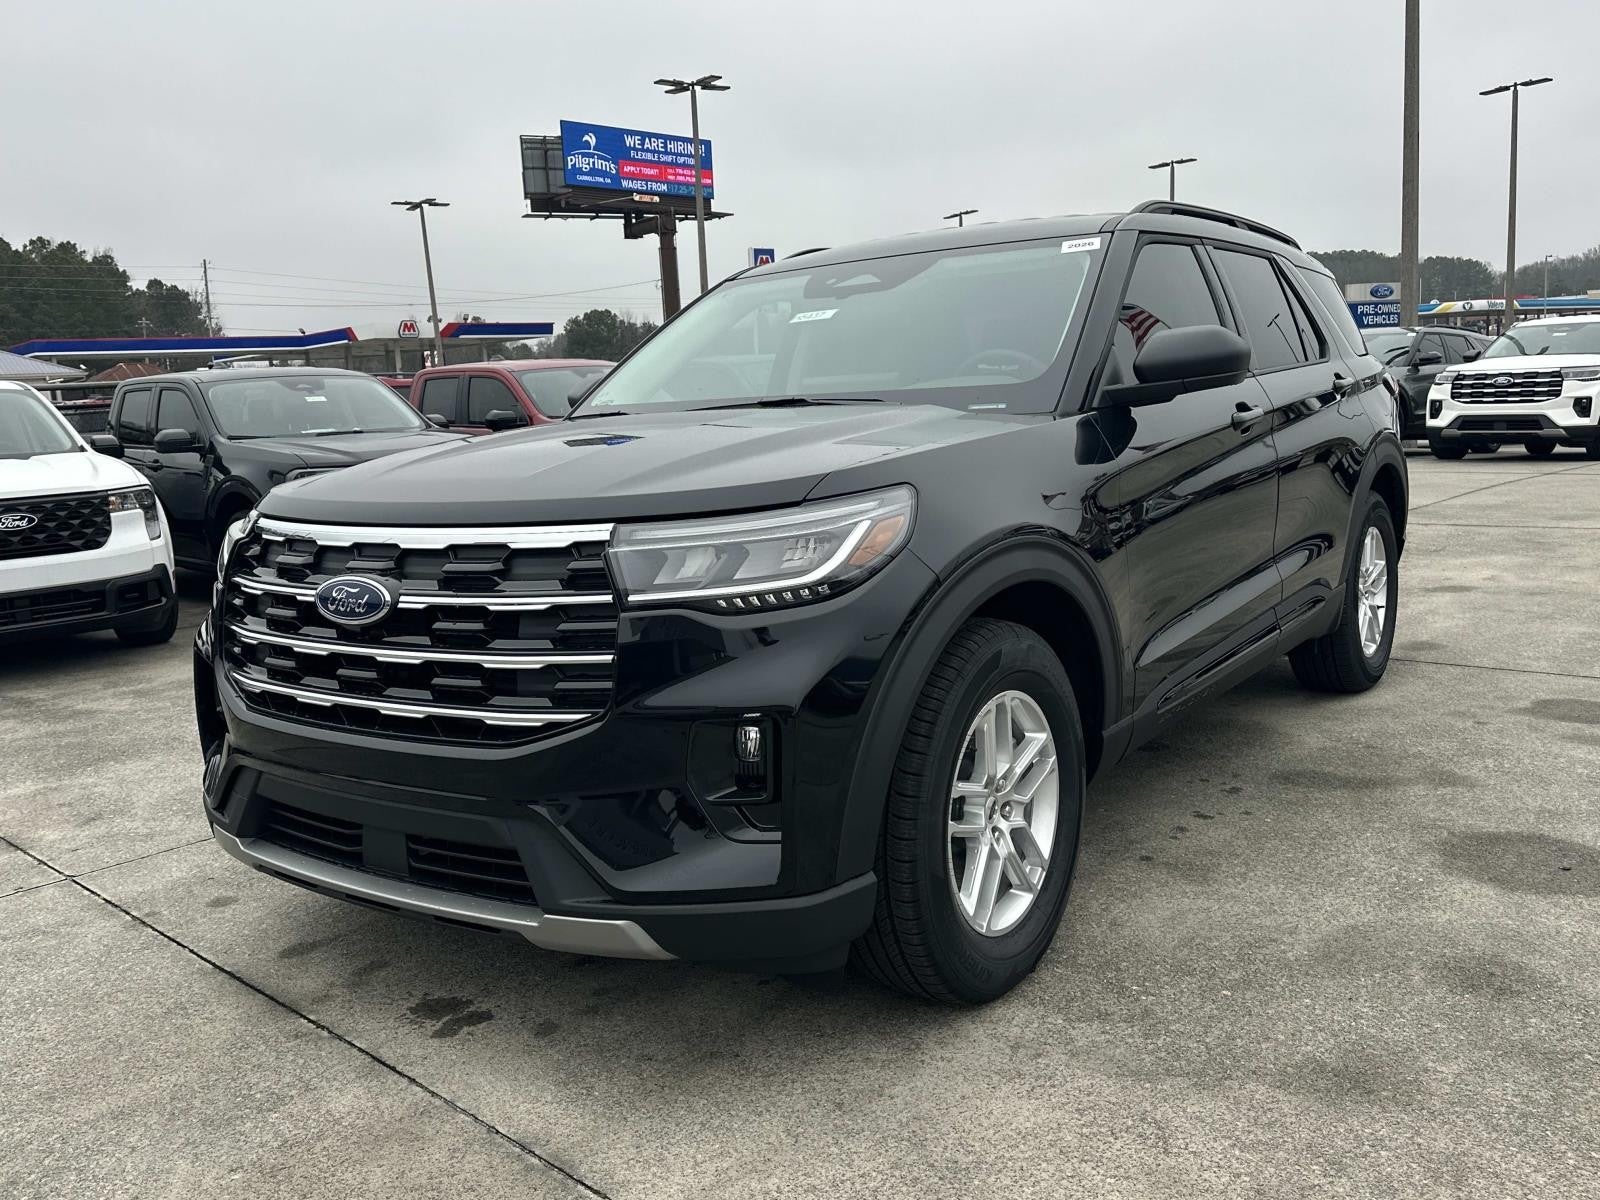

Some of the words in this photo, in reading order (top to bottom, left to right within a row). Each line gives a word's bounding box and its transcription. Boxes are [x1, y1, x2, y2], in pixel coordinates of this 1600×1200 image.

[624, 134, 641, 149] WE
[644, 137, 665, 151] ARE
[567, 154, 616, 174] Pilgrim's
[630, 151, 659, 161] FLEXIBLE
[660, 153, 676, 163] SHIFT
[677, 156, 695, 165] OPTIO
[620, 179, 647, 190] WAGES
[647, 181, 667, 192] FROM
[1067, 241, 1095, 249] 2026
[1362, 314, 1399, 325] VEHICLES
[0, 516, 28, 528] Ford
[327, 585, 370, 613] Ford
